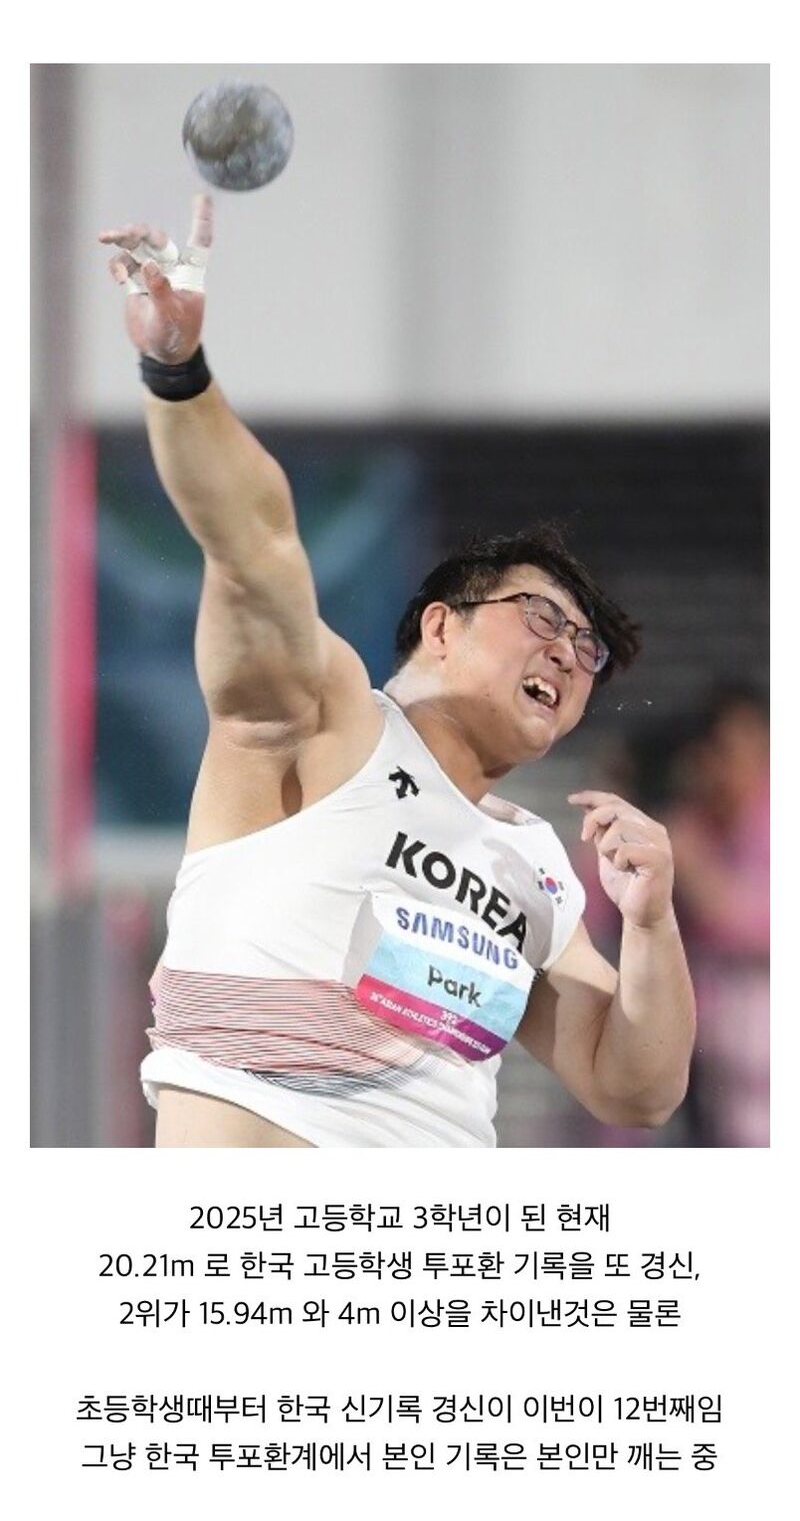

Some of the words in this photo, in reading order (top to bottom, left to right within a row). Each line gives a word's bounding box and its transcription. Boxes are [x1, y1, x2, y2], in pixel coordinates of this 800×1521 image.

[385, 830, 528, 954] KOREA
[395, 907, 519, 971] SAMSUNG
[427, 964, 482, 1009] Park
